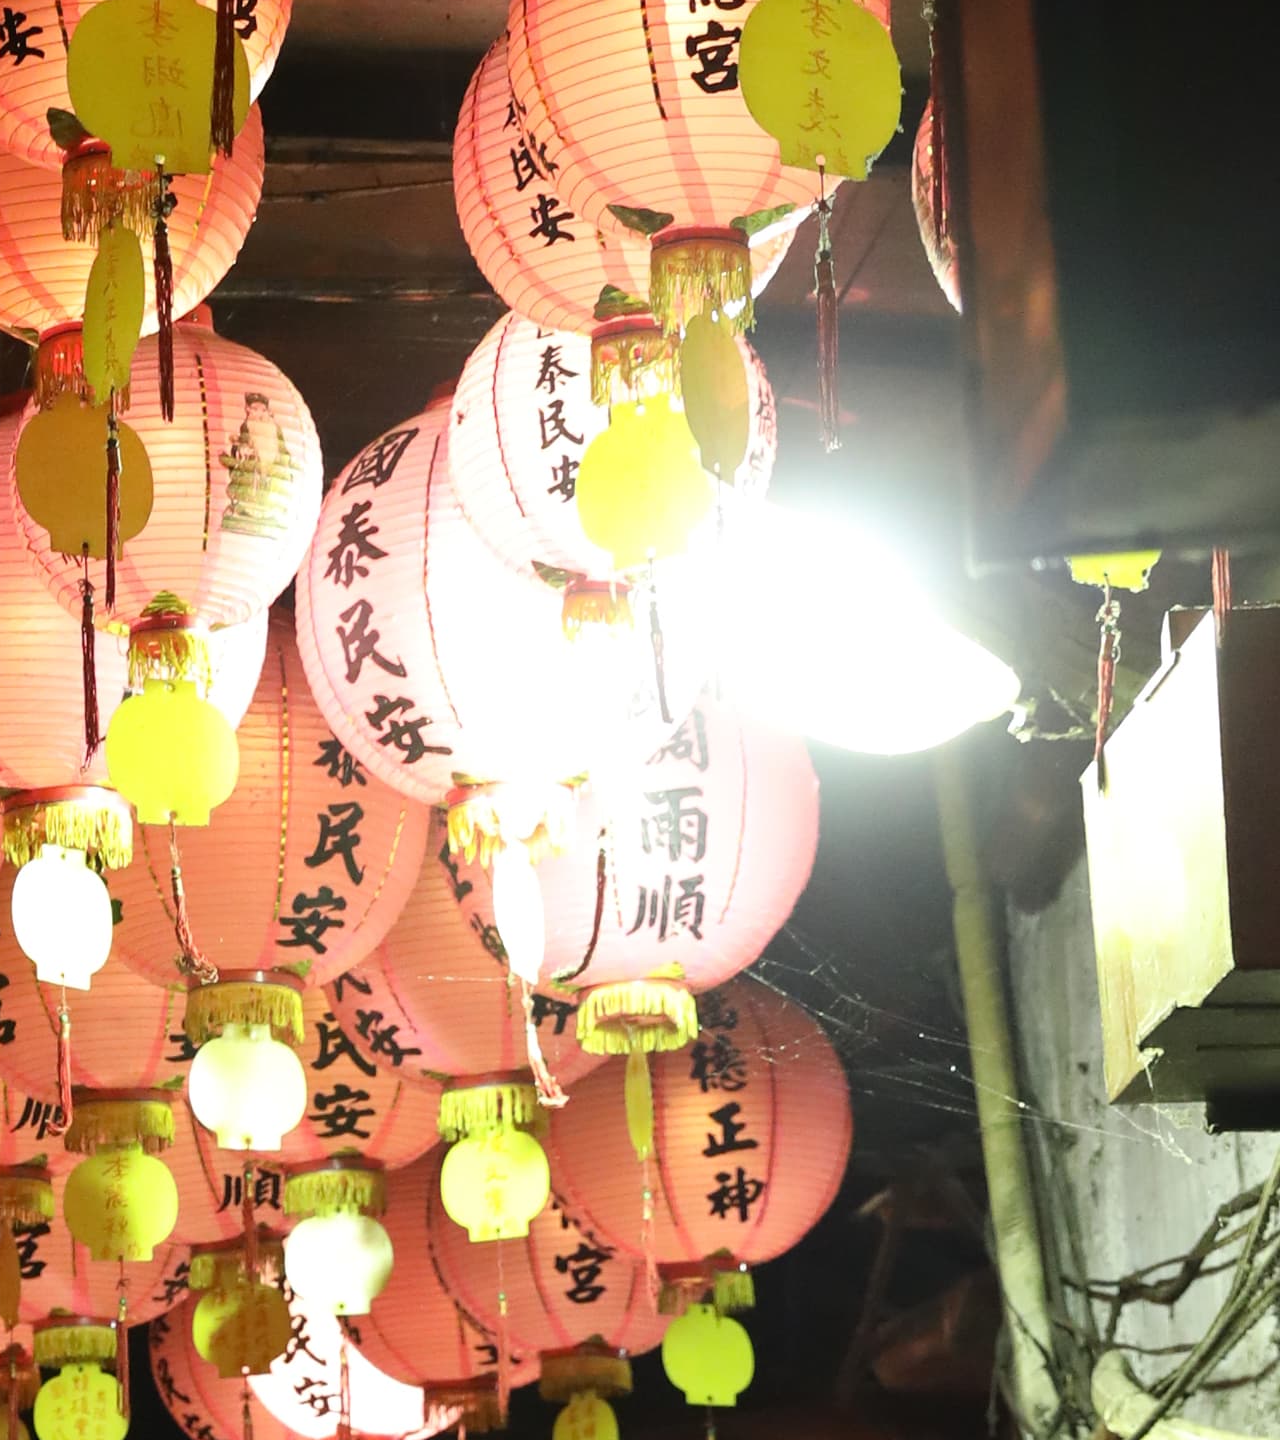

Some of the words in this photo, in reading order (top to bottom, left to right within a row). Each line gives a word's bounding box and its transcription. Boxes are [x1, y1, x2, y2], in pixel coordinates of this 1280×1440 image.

[325, 428, 452, 764] 國泰民安
[306, 1010, 378, 1140] 民安
